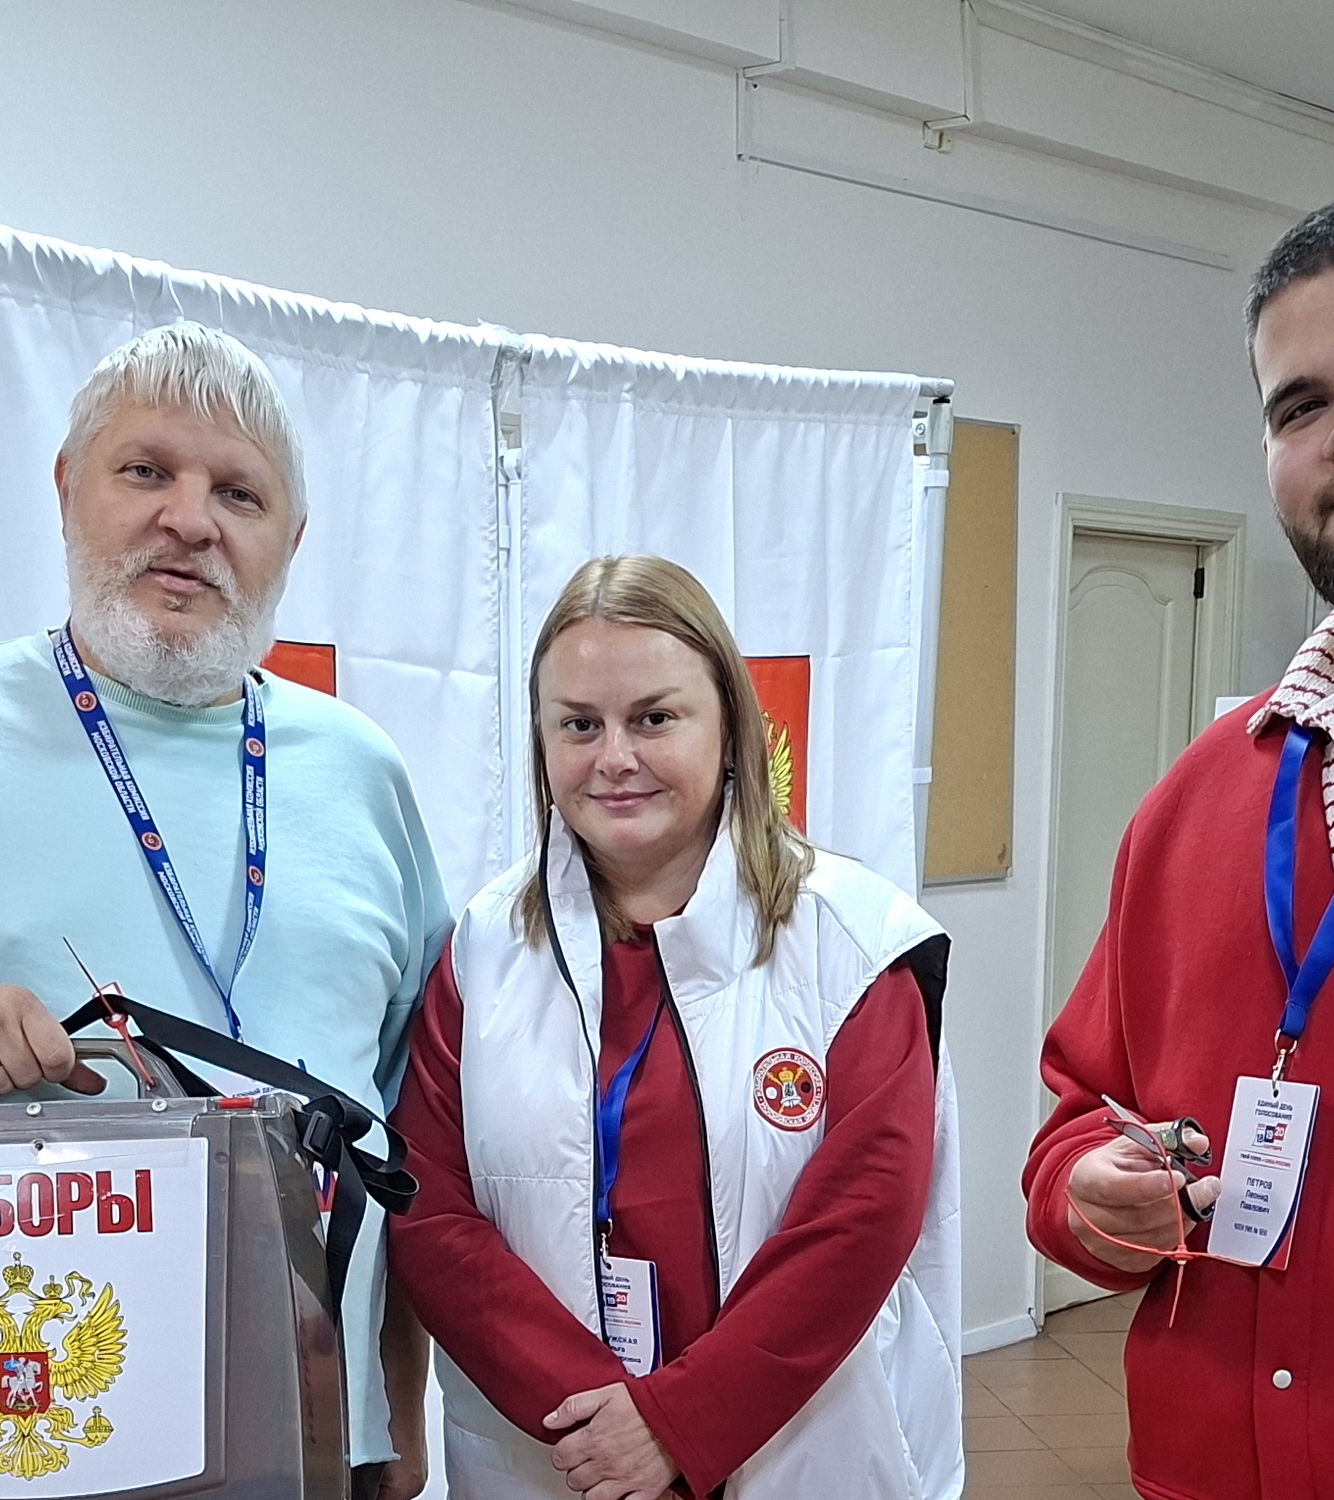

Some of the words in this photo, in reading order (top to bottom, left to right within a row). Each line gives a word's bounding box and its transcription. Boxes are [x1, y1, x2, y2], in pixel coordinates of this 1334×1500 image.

[90, 730, 120, 780] МОСКОВСКОЙ
[113, 779, 136, 813] ОБЛАСТИ
[124, 779, 149, 821] КОМИССИЯ
[1274, 1127, 1284, 1137] 20
[1247, 1177, 1273, 1190] ПЕТРОВ
[616, 1294, 627, 1303] 20
